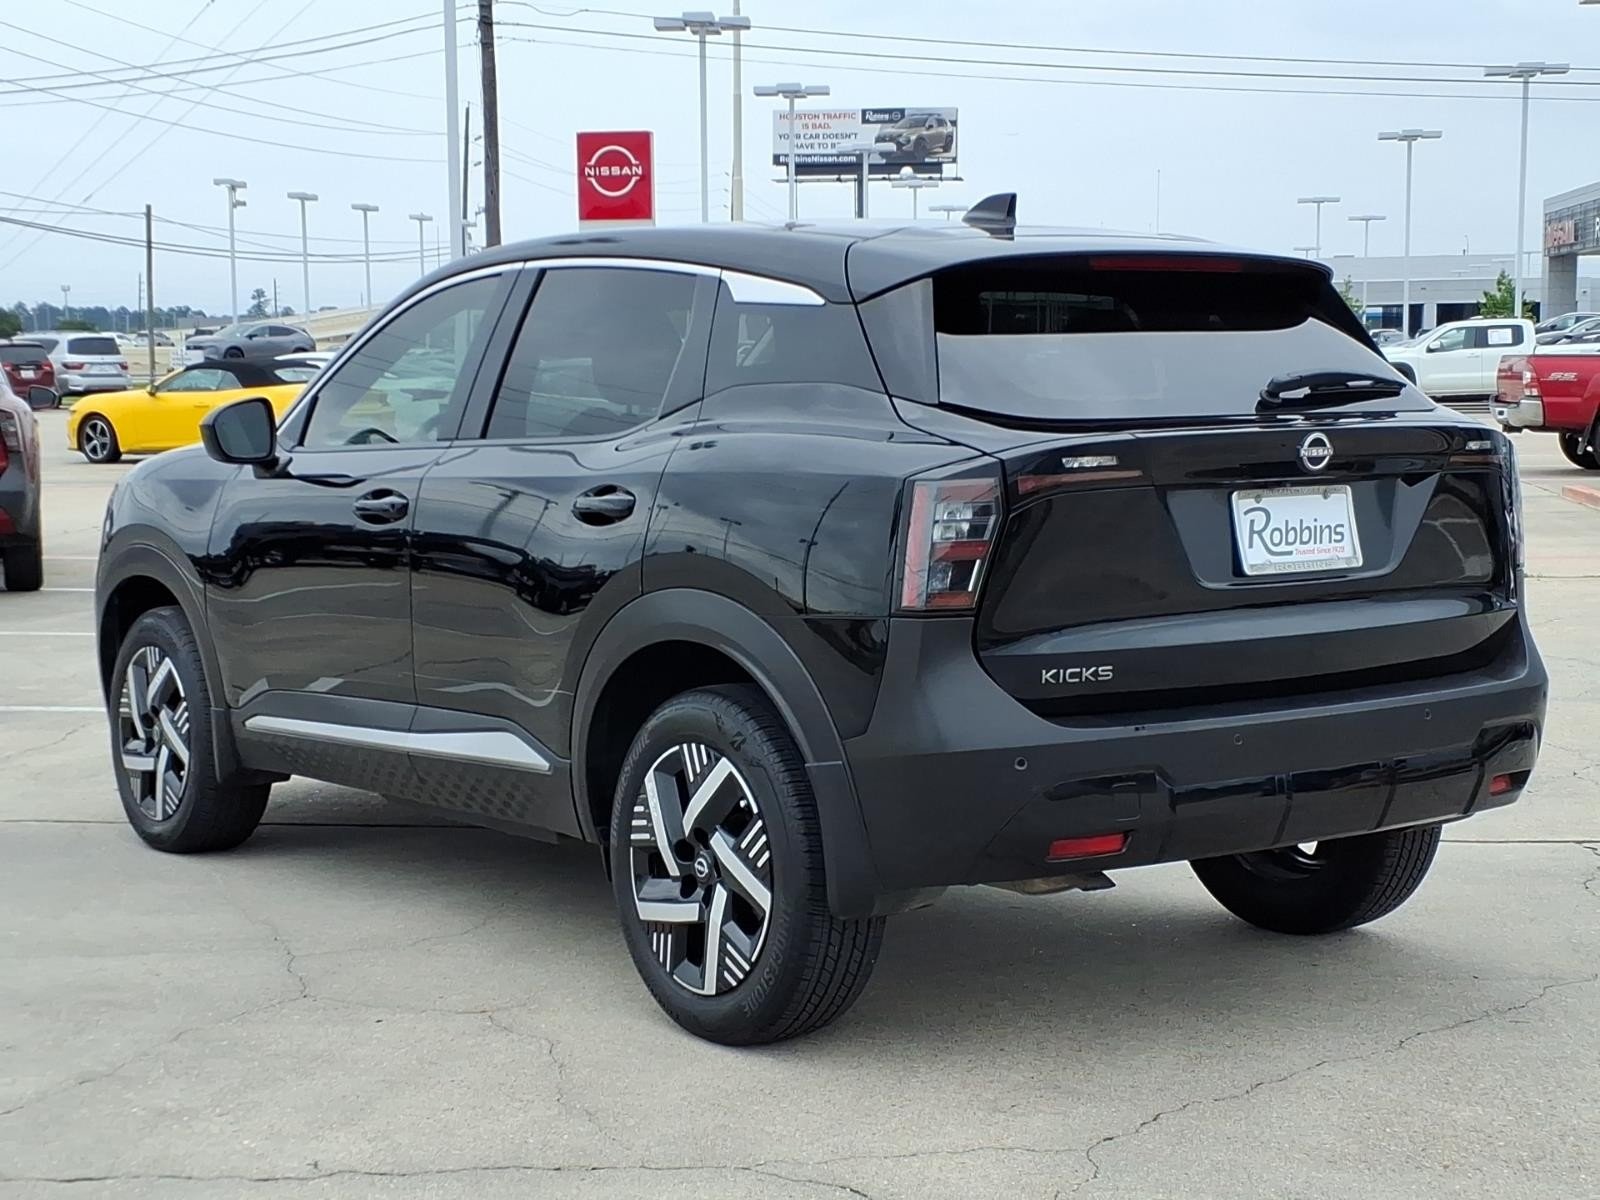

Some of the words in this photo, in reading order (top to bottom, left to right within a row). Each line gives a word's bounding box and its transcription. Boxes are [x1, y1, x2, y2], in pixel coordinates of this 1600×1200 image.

[779, 112, 820, 121] HOUSTON
[822, 112, 857, 120] TRAFFIC
[801, 122, 809, 130] IS
[778, 132, 801, 140] YOR
[822, 132, 858, 140] DOESN'T
[830, 142, 841, 150] B
[779, 155, 857, 163] RobinsNissan.com
[585, 165, 642, 176] NISSAN
[1300, 447, 1334, 457] NISSAN
[1243, 506, 1345, 557] Robbins
[1041, 665, 1113, 684] KICKS
